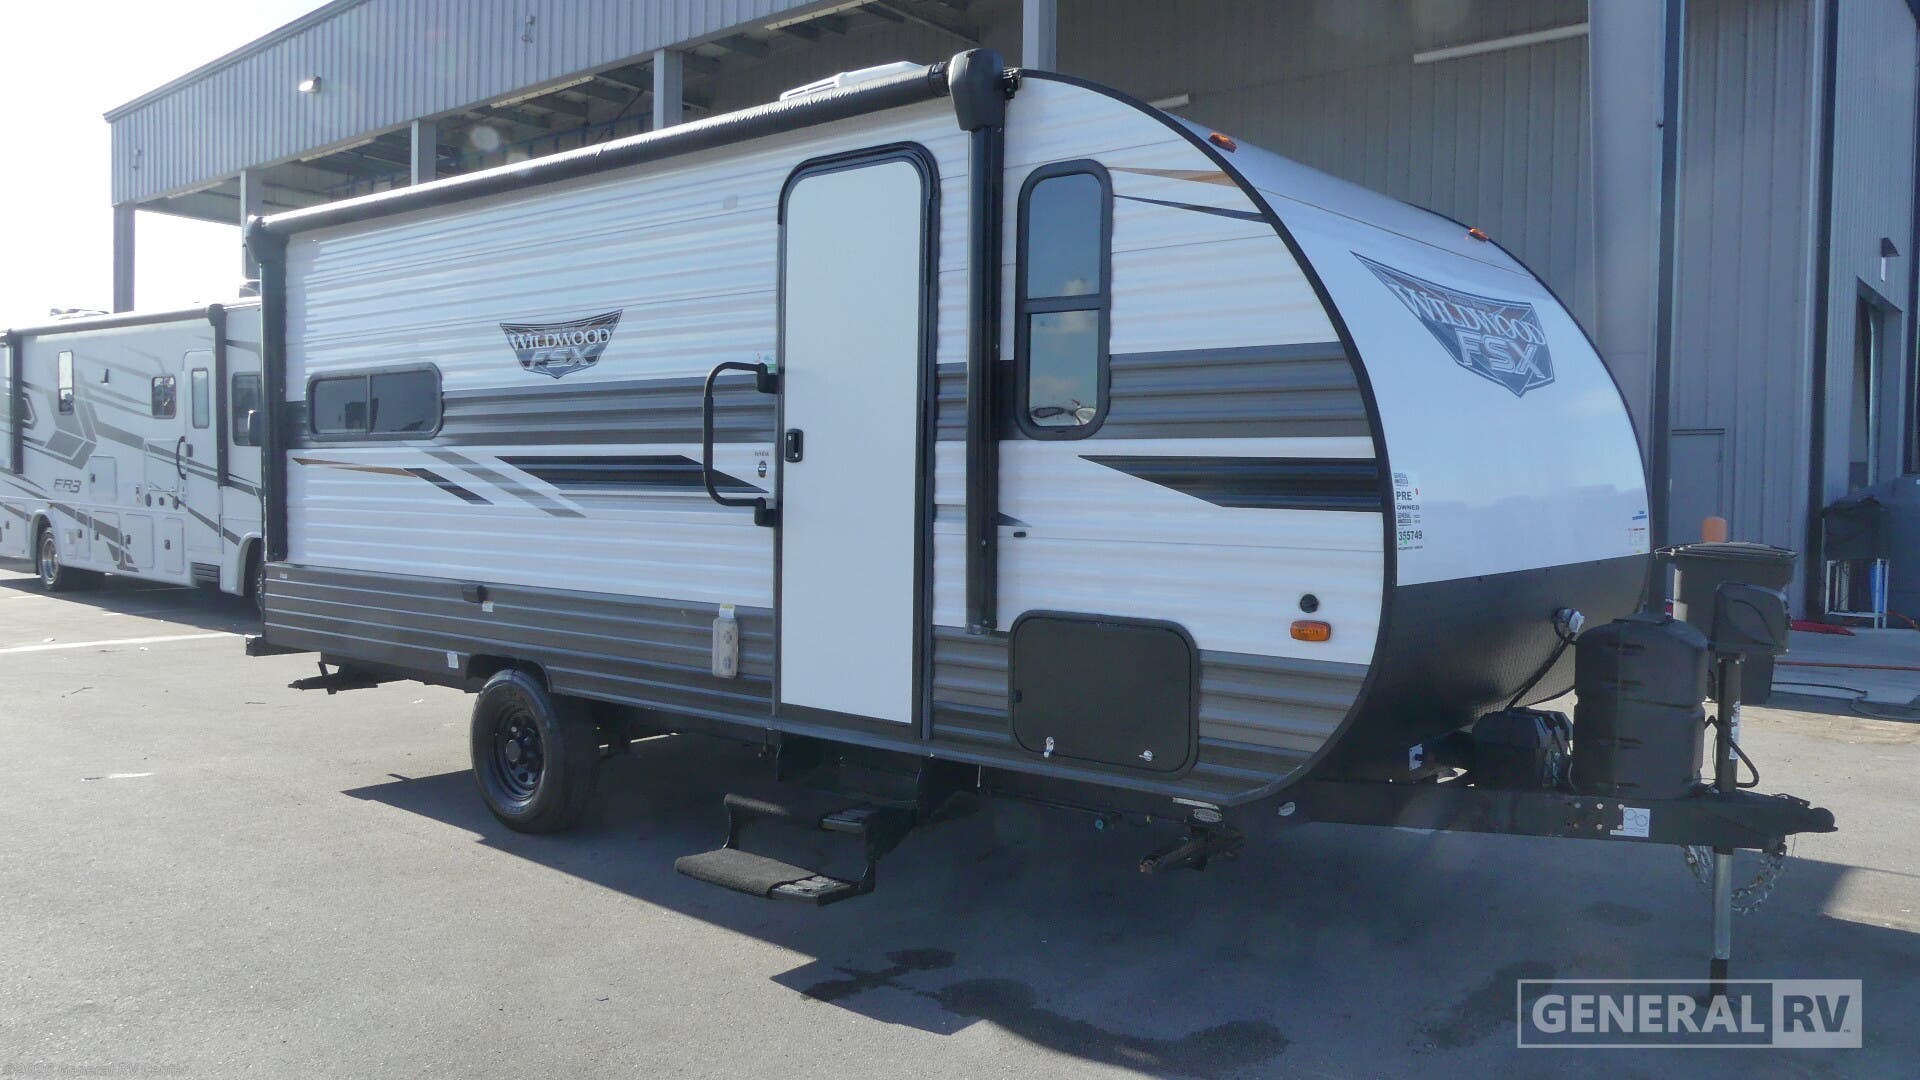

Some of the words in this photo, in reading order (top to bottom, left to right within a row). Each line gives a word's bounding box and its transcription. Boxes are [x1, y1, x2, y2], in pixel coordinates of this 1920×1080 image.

[1387, 283, 1546, 345] WILDWOOD
[510, 328, 611, 350] WILDWOOD
[1454, 327, 1547, 379] FSX
[54, 478, 82, 493] FR3
[1396, 491, 1413, 501] PRE
[1398, 530, 1423, 541] 355749
